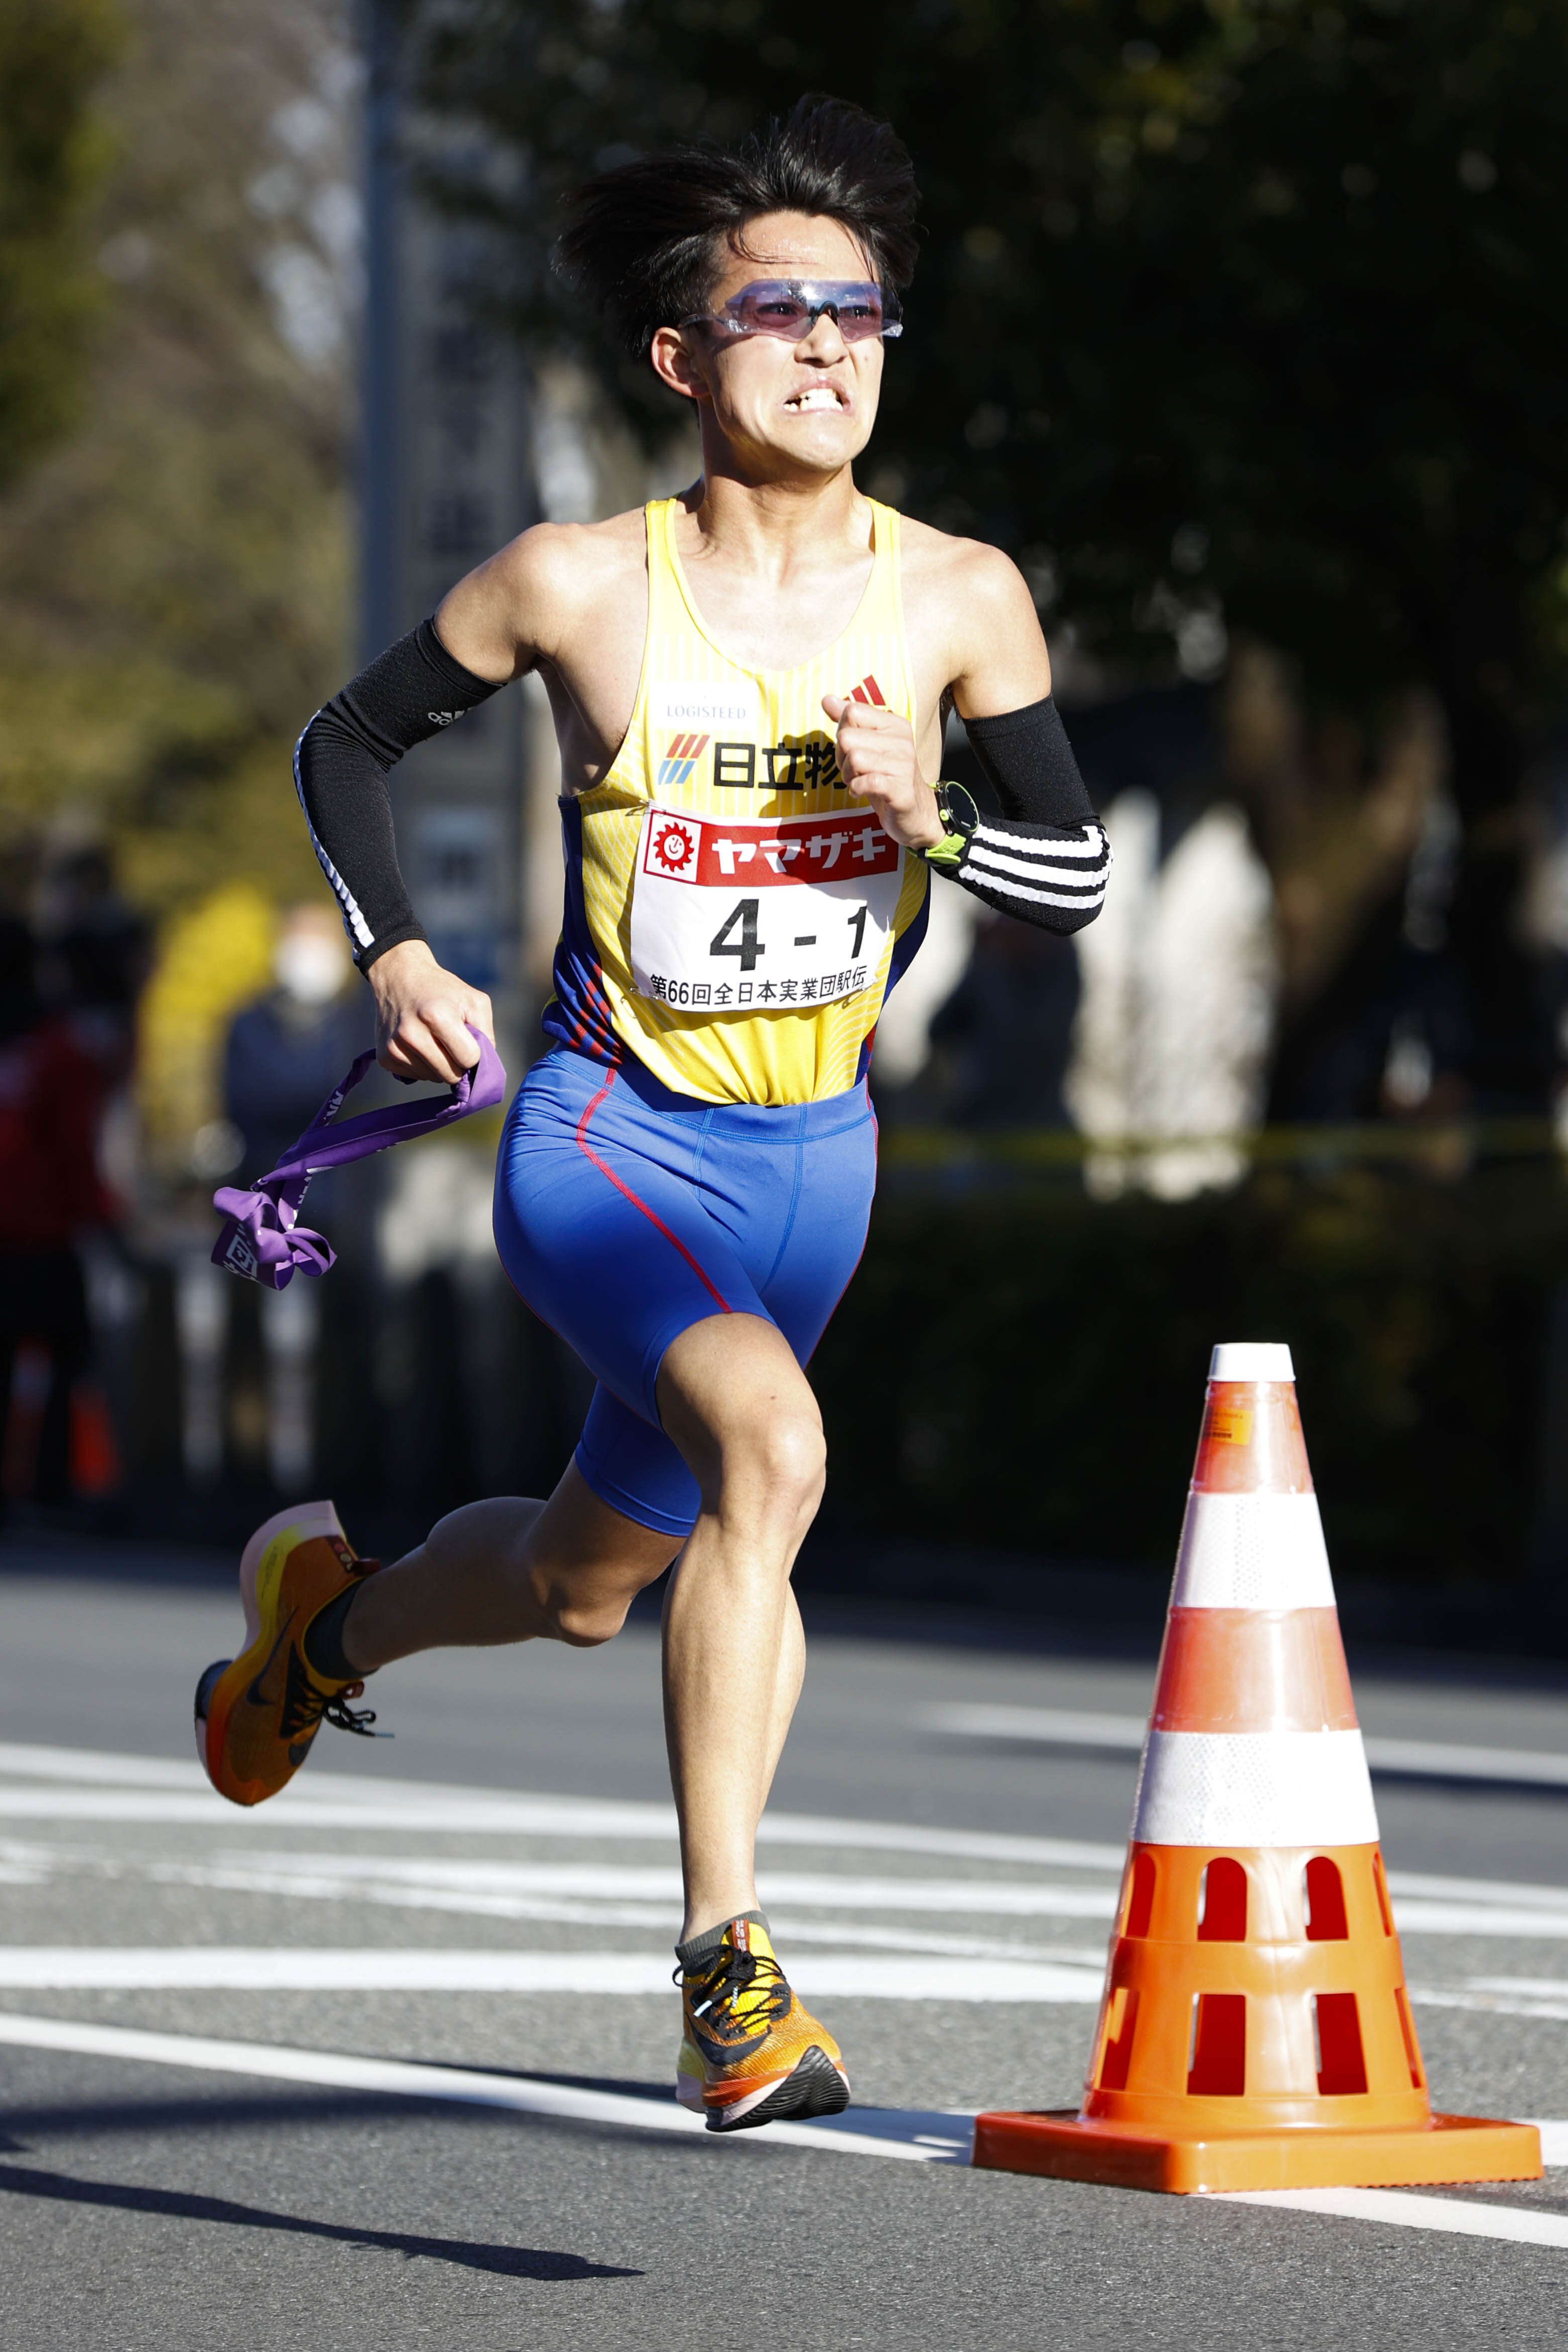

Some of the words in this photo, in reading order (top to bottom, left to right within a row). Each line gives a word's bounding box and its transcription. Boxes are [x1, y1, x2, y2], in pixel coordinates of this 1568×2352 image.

[667, 705, 746, 719] LOGISTEED
[711, 825, 887, 874] ヤマザキ
[650, 965, 867, 1005] 第66回全日本実業団駅伝
